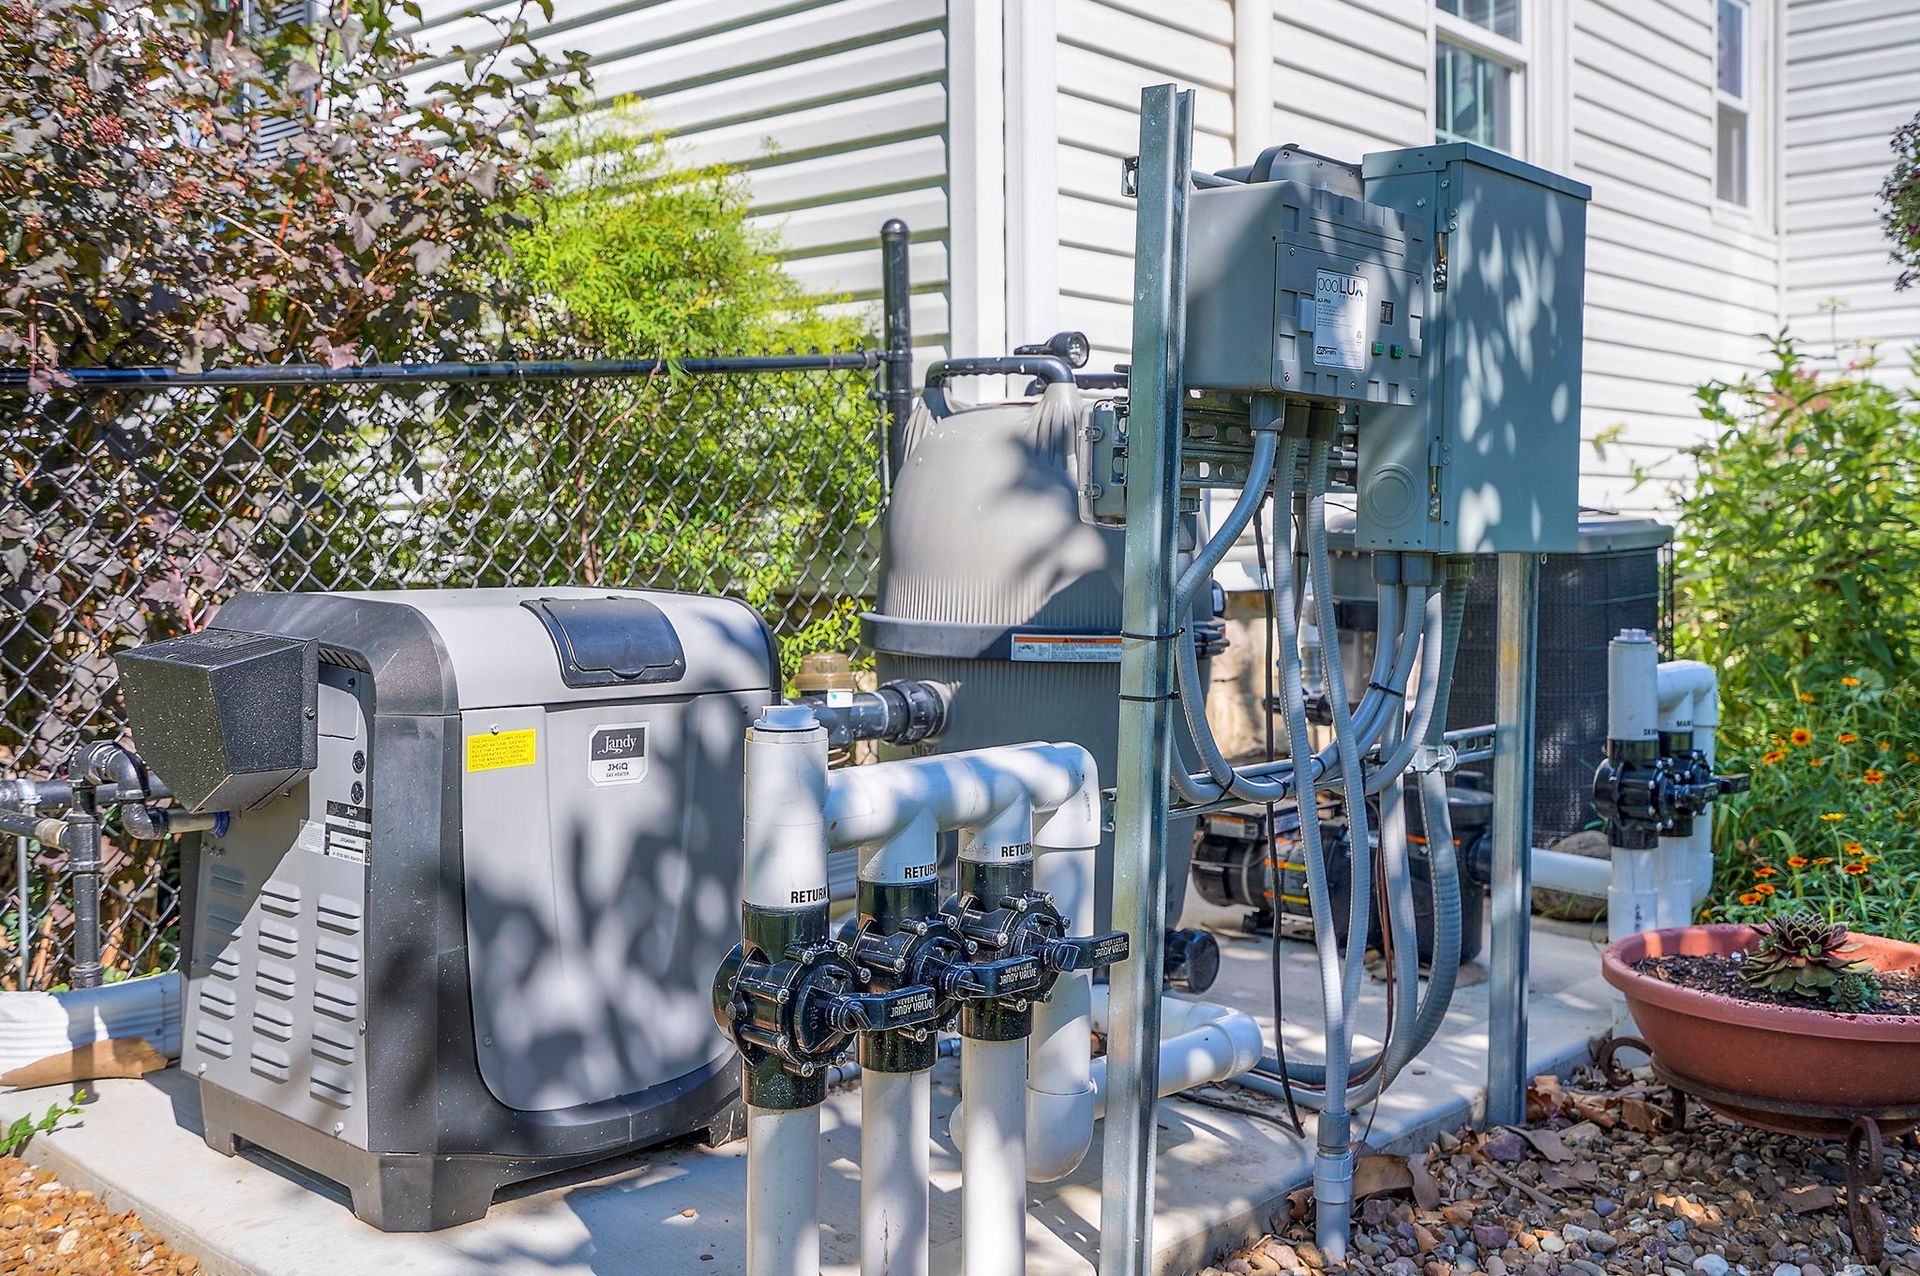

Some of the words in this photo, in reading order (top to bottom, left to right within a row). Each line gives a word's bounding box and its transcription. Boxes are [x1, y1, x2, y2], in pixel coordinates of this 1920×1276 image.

[597, 734, 637, 754] Jandy
[1020, 968, 1037, 980] VALVE
[890, 1004, 912, 1017] JANDY
[912, 999, 932, 1012] VALVE
[896, 996, 914, 1006] NEVER
